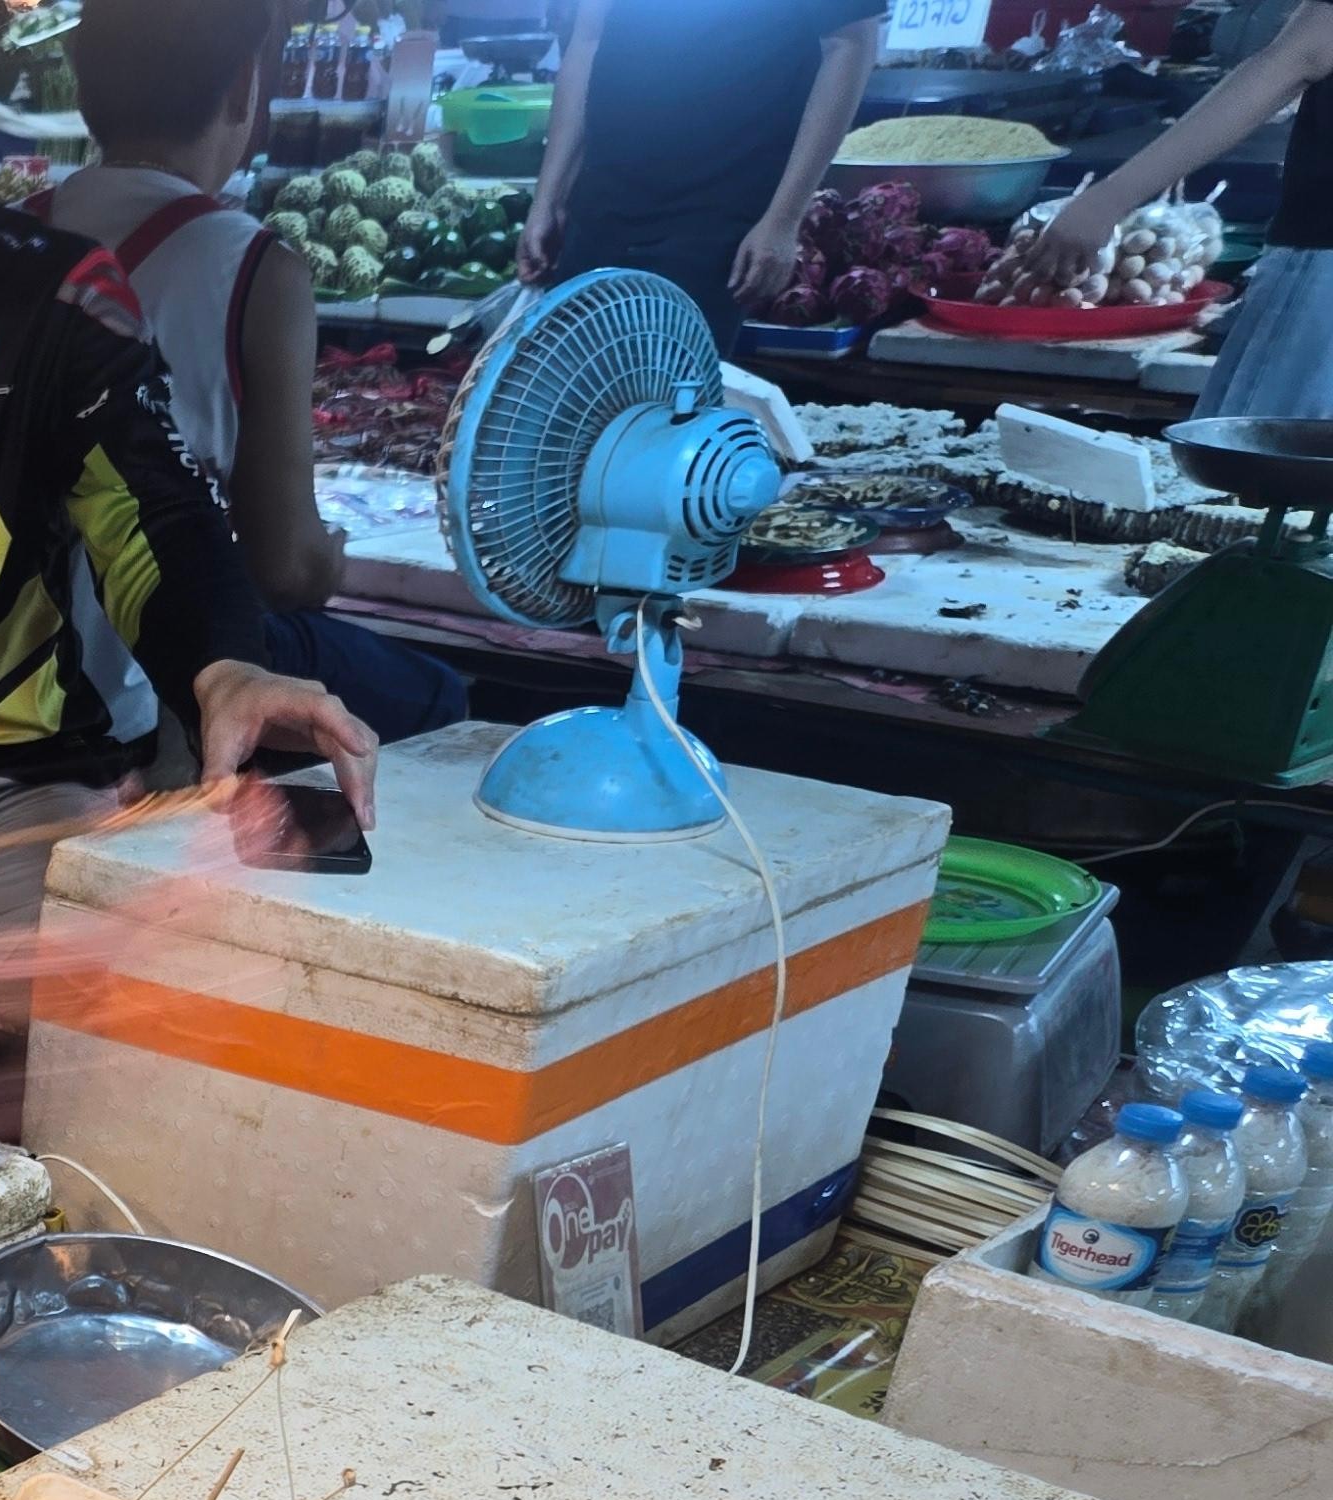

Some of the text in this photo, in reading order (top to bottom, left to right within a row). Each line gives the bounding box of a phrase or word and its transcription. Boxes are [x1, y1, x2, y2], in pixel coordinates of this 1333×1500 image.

[545, 1198, 592, 1264] One
[588, 1212, 630, 1264] pay
[1050, 1231, 1134, 1268] Tigerhead
